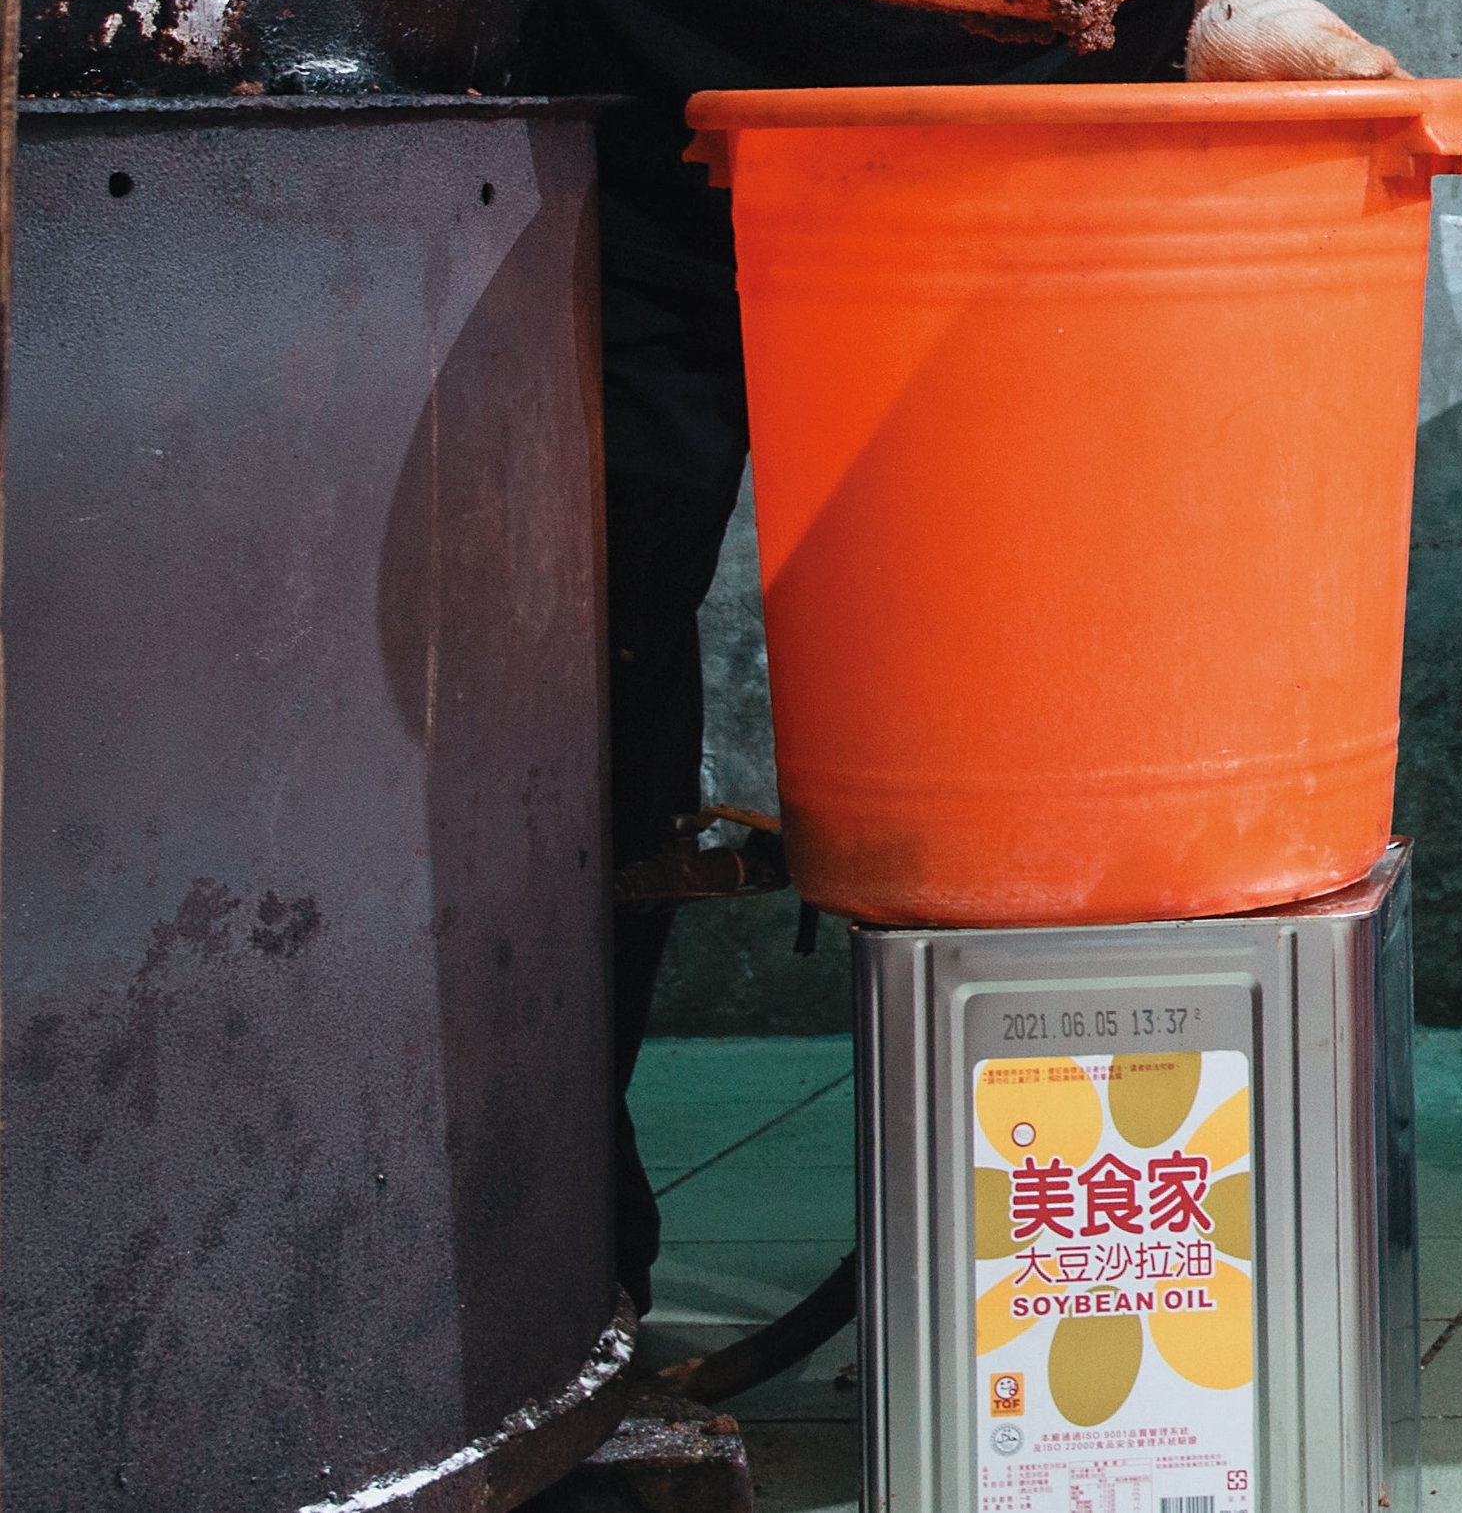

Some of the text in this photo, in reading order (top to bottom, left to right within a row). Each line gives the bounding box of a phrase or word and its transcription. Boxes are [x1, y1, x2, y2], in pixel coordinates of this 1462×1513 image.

[1002, 1010, 1118, 1040] 2021.06.05
[1131, 1007, 1188, 1036] 13:37
[1012, 1149, 1212, 1239] 美食家
[1014, 1239, 1212, 1286] 大豆沙拉油
[1012, 1289, 1213, 1317] SOYBEAN OIL
